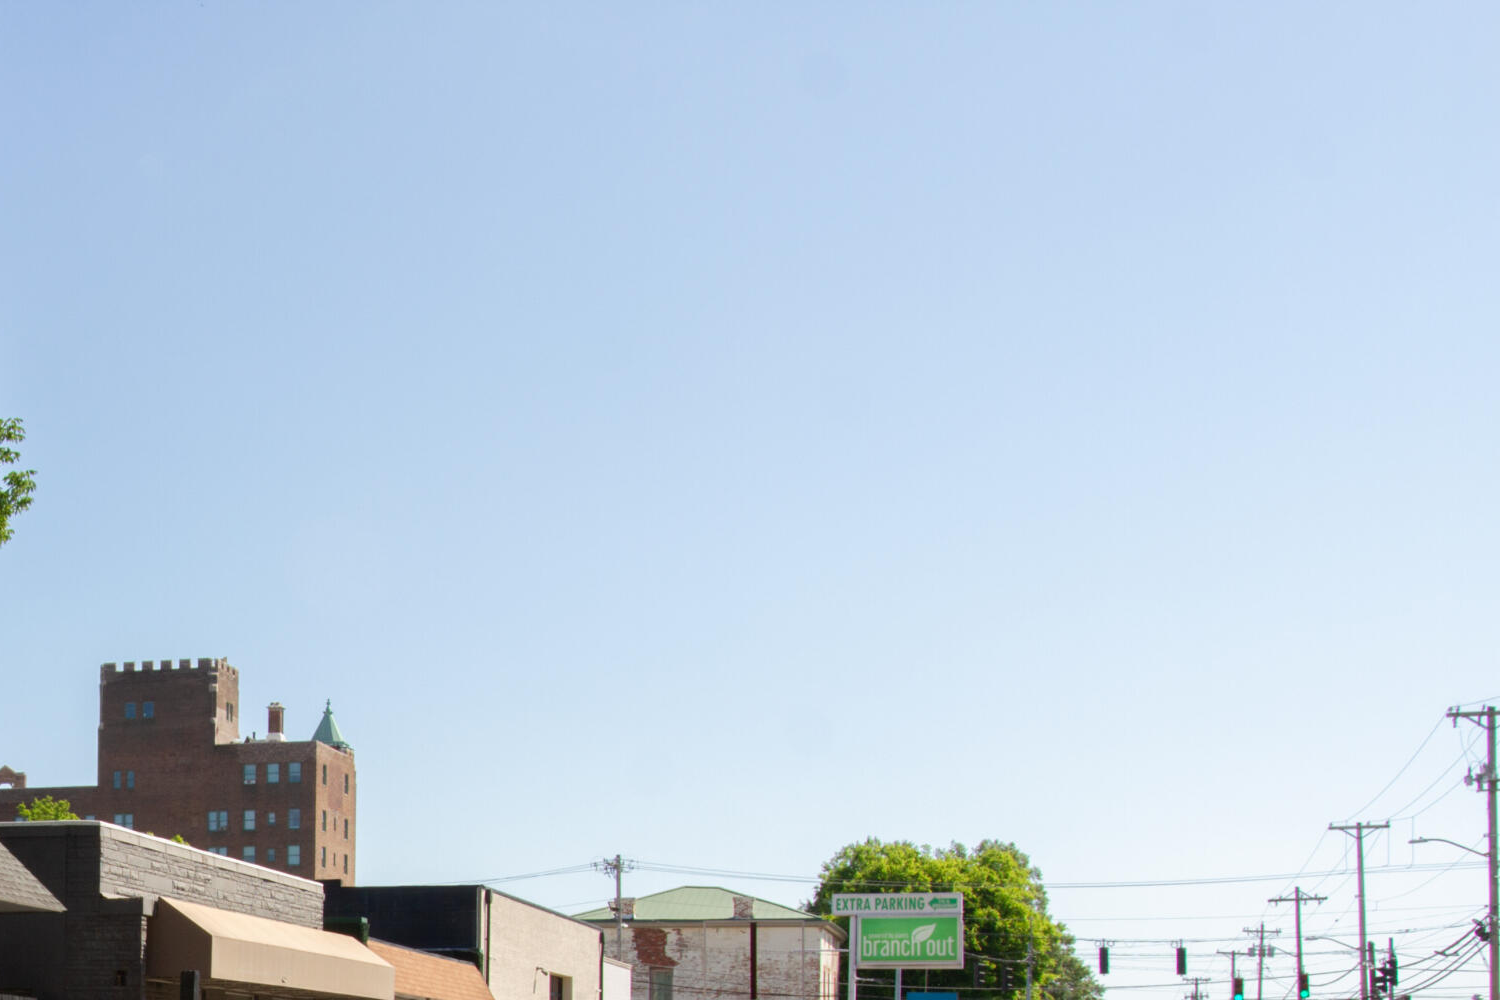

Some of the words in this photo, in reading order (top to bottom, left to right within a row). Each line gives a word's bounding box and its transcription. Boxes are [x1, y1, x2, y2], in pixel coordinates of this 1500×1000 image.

[836, 898, 871, 911] EXTRA
[875, 897, 925, 911] PARKING
[863, 935, 921, 957] branch
[926, 935, 955, 957] out
